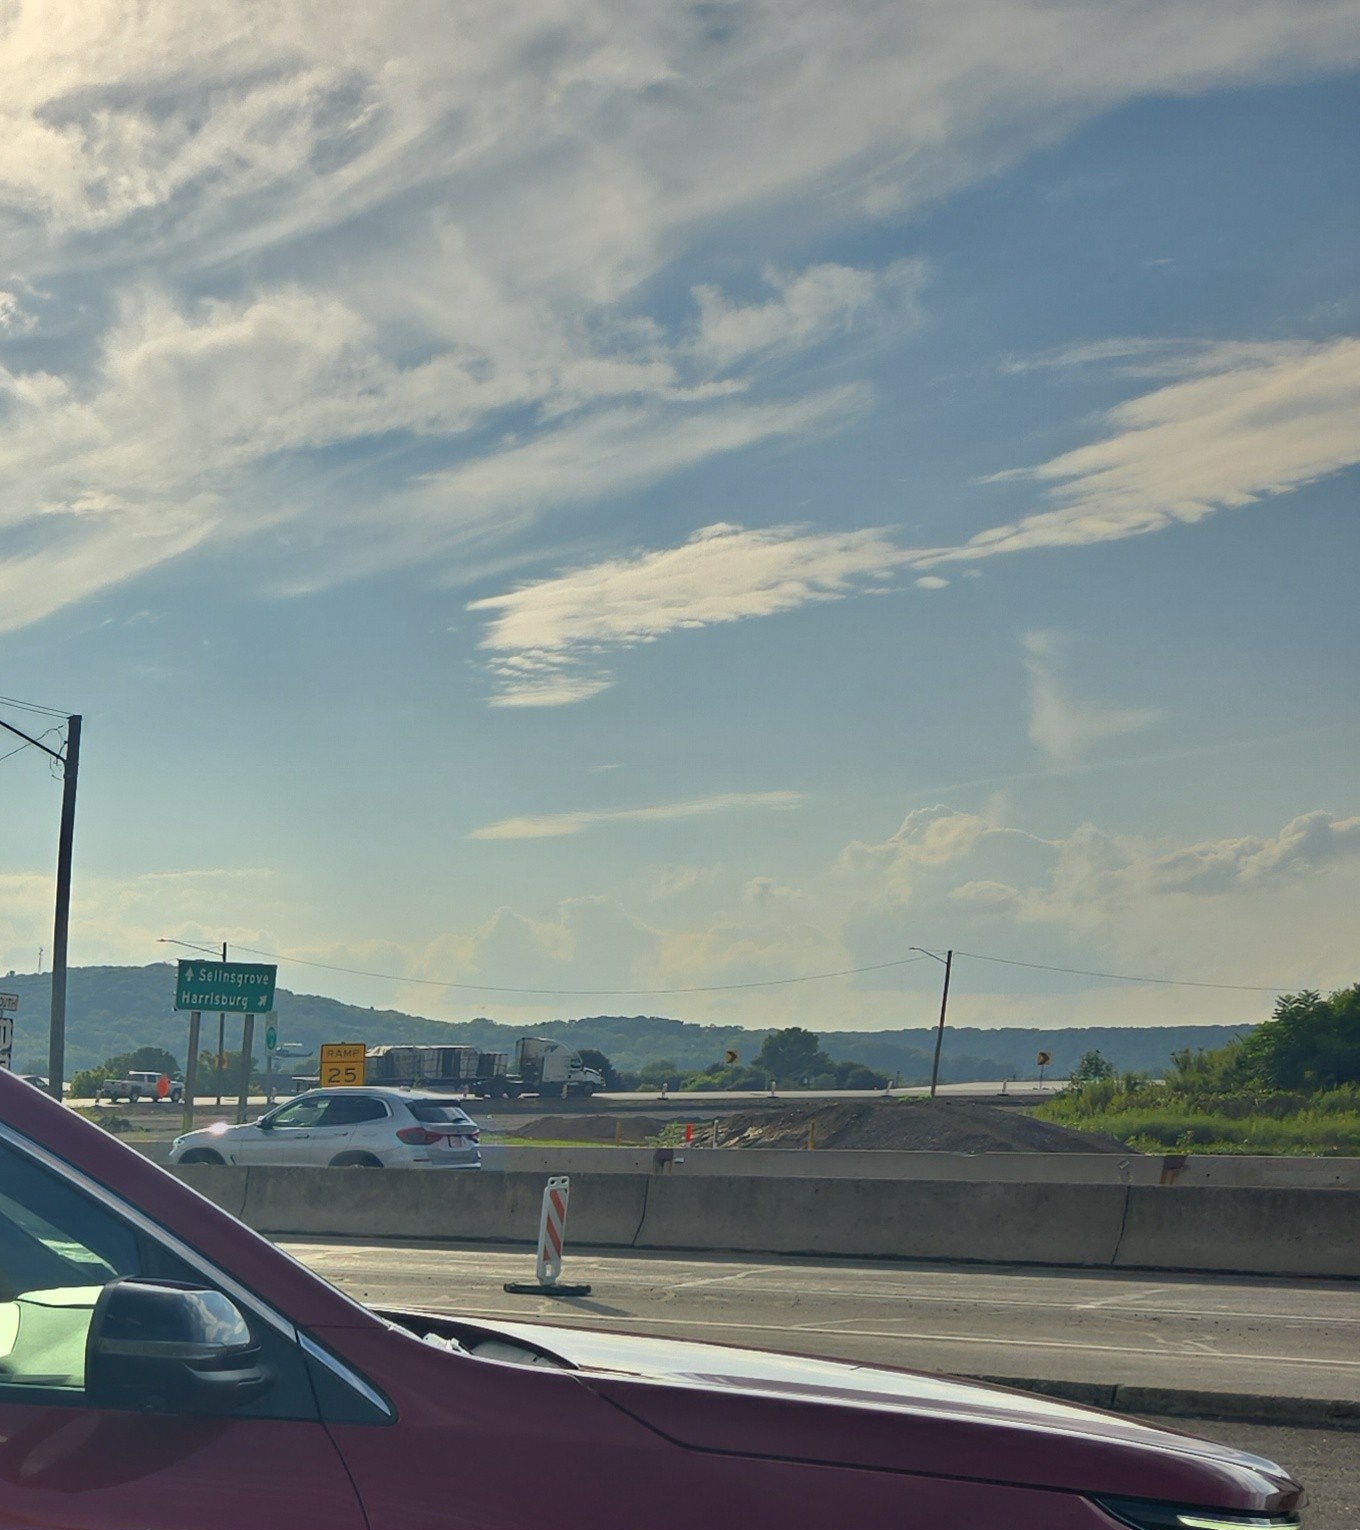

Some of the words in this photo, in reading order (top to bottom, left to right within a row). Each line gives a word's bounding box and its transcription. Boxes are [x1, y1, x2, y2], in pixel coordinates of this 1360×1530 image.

[198, 968, 269, 987] Selinsgrove
[182, 990, 248, 1010] Harrisburg
[327, 1049, 359, 1057] RAMP
[328, 1067, 357, 1083] 25
